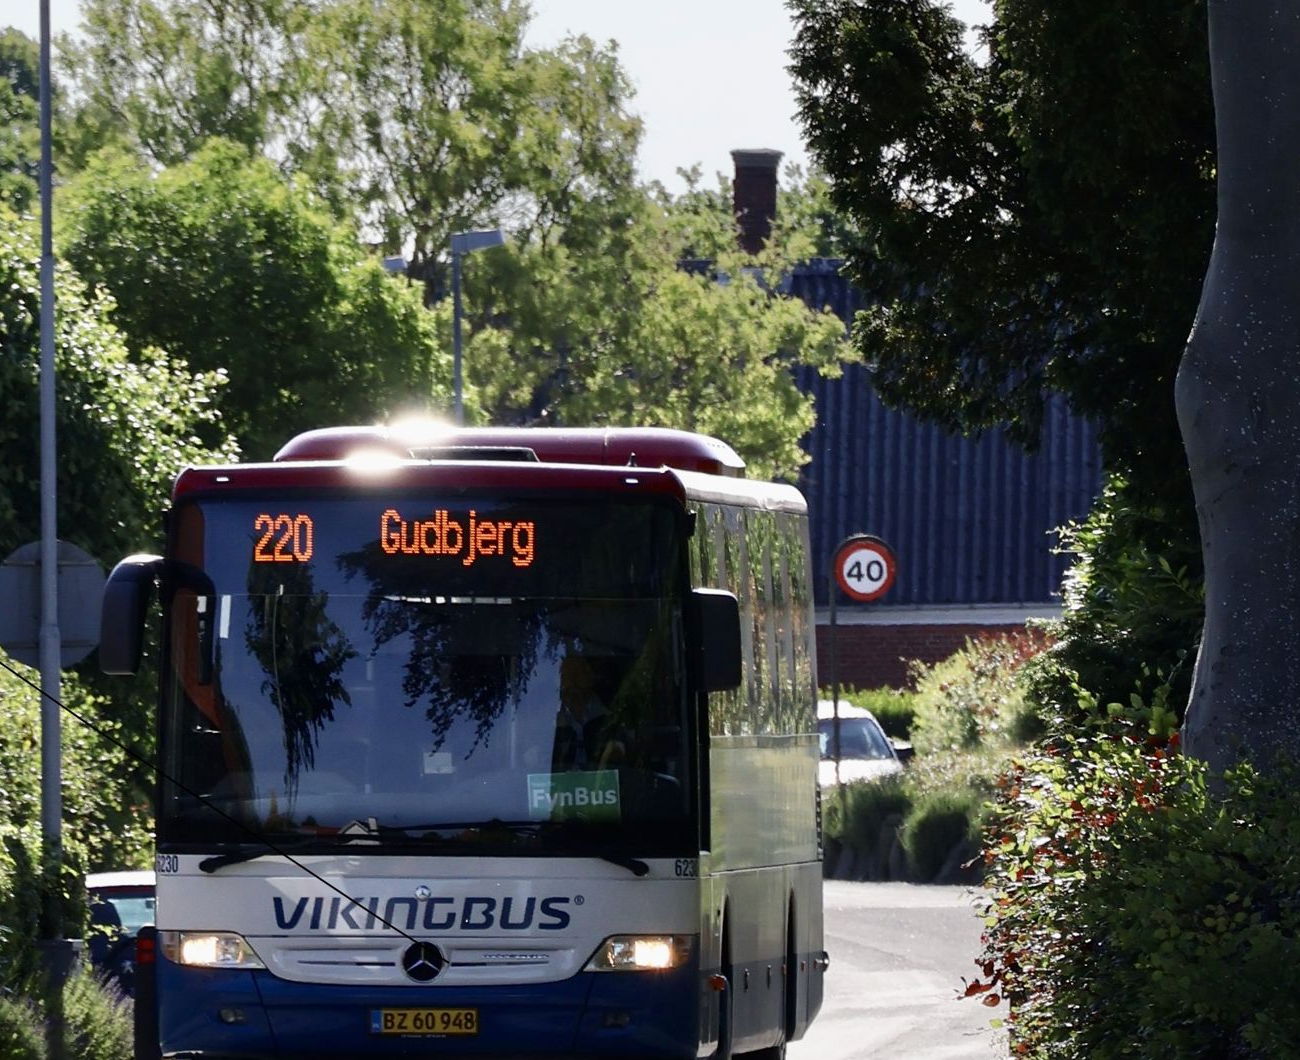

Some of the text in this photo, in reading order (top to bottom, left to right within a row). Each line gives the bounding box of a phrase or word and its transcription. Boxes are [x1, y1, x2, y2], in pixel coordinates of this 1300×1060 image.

[254, 509, 534, 566] 220 Gudbjerg
[846, 560, 884, 582] 40
[532, 787, 618, 812] FynBus
[383, 1012, 409, 1030] BZ
[412, 1011, 436, 1031] 60
[440, 1011, 475, 1031] 948
